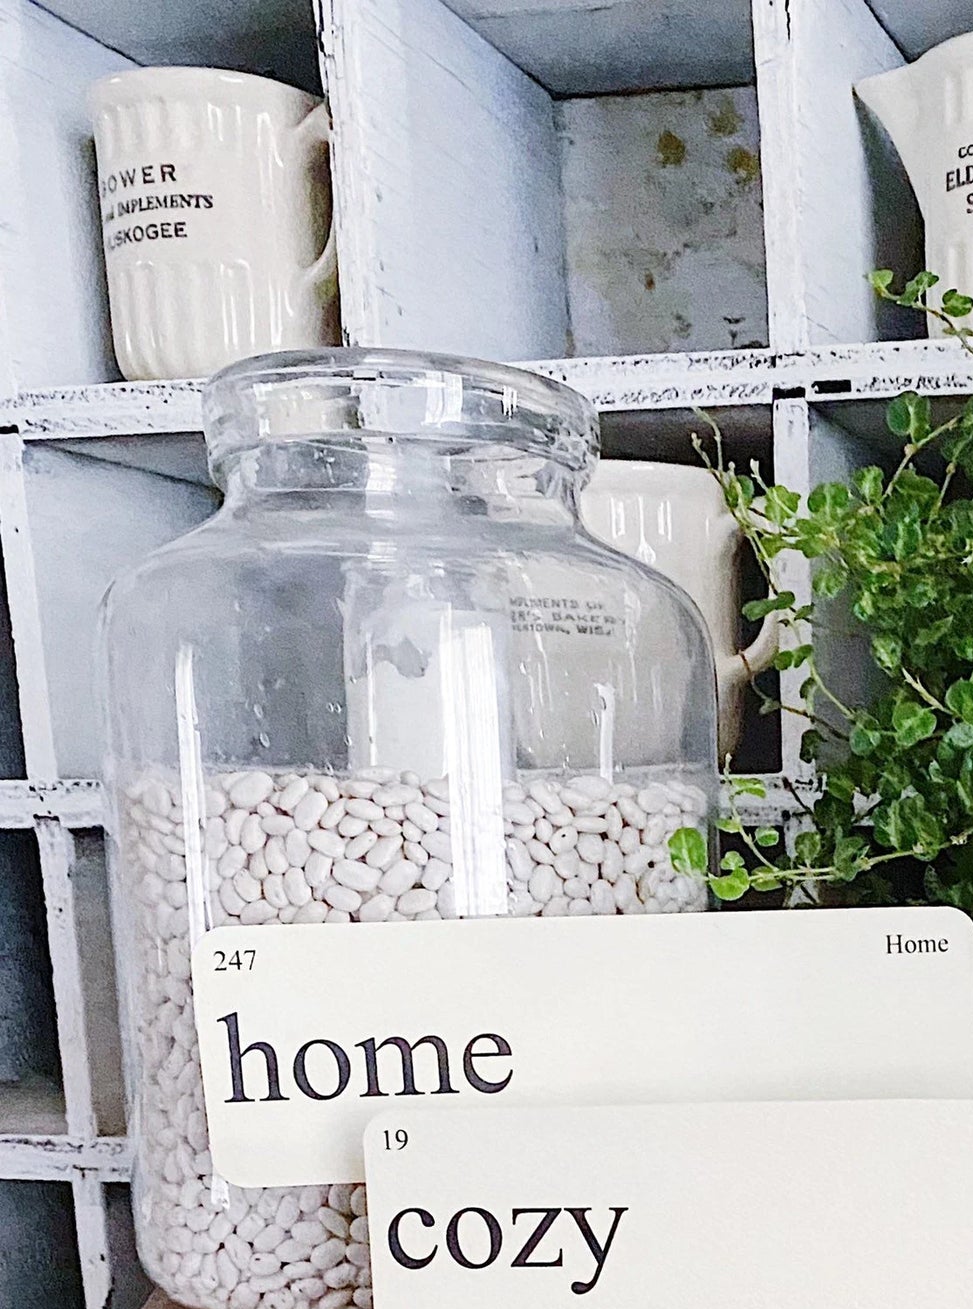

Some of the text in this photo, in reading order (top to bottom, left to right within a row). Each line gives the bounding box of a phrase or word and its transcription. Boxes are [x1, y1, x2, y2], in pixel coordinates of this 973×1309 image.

[886, 934, 949, 954] Home
[213, 949, 257, 972] 247
[216, 1012, 514, 1103] home
[383, 1129, 409, 1150] 19
[387, 1206, 629, 1295] cozy
